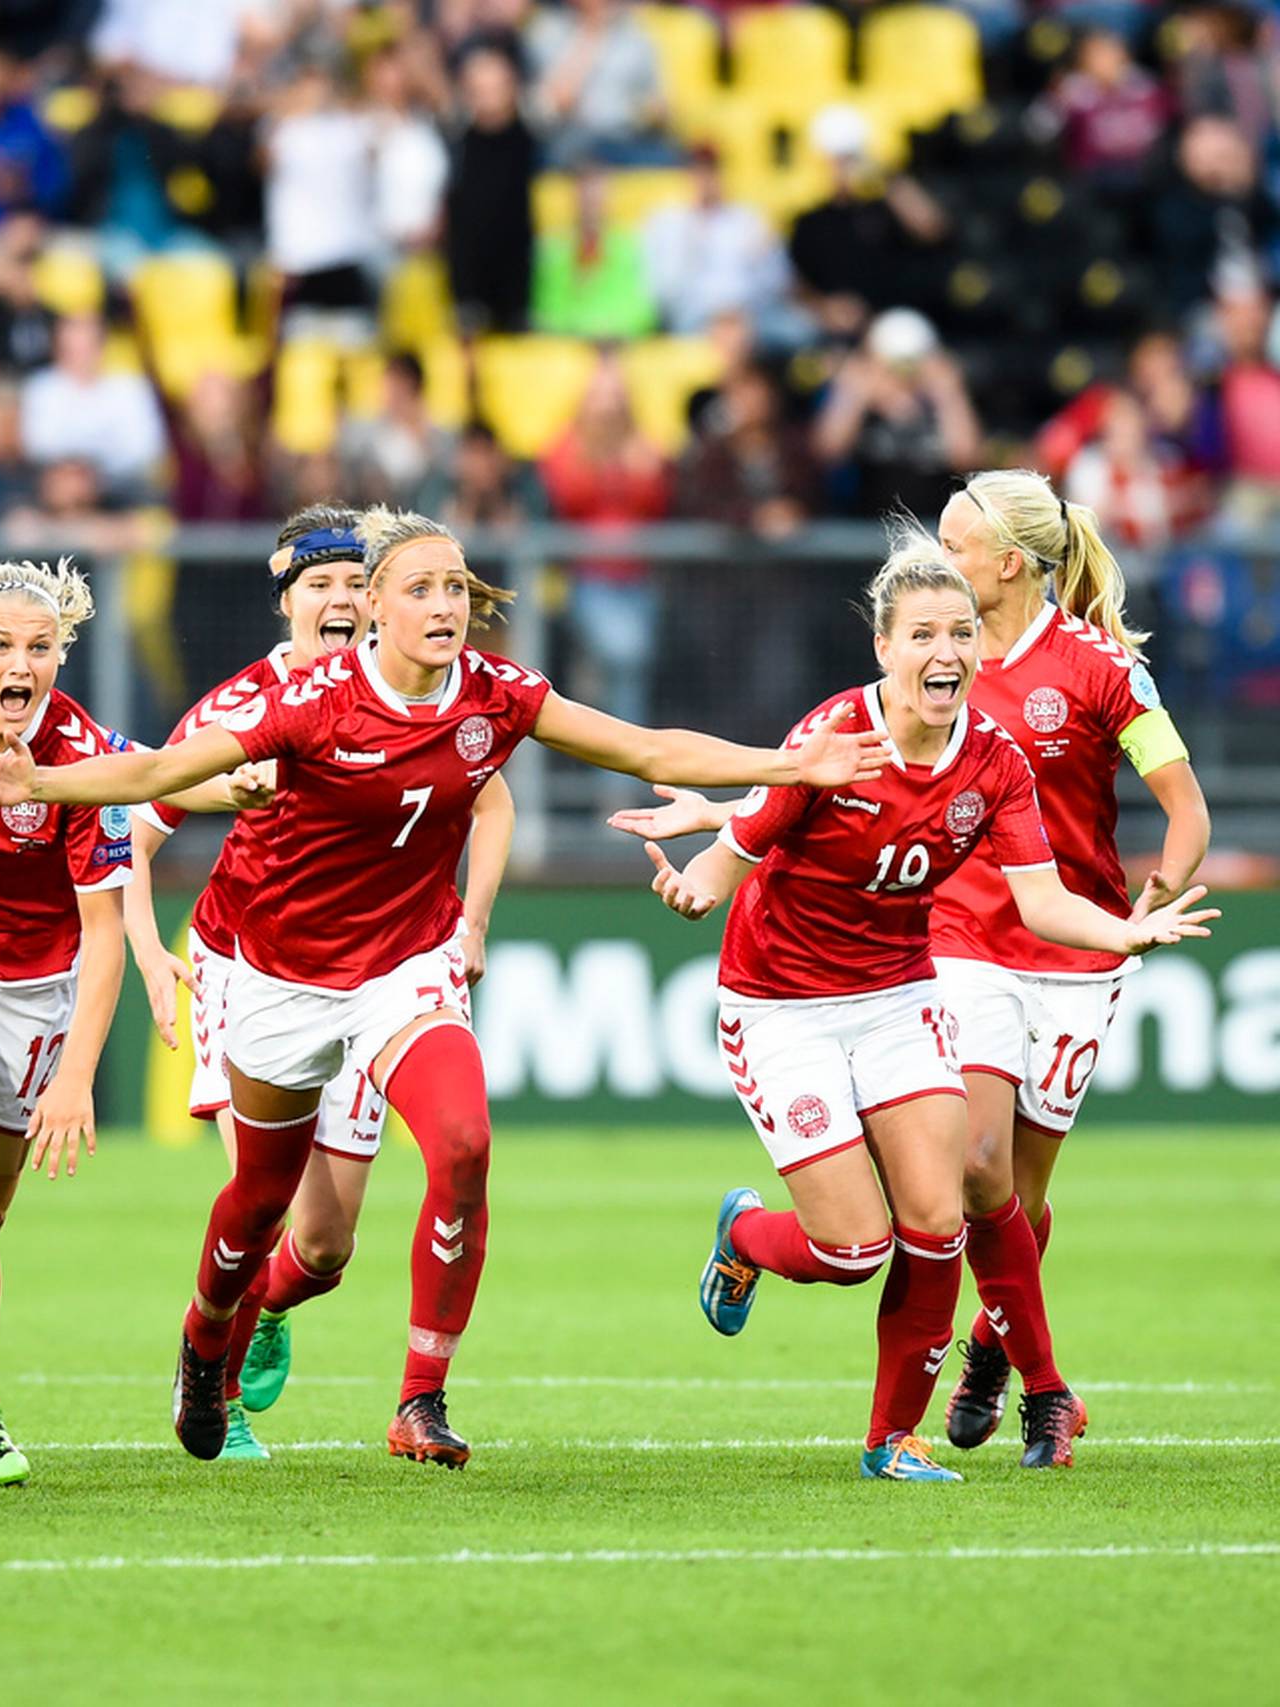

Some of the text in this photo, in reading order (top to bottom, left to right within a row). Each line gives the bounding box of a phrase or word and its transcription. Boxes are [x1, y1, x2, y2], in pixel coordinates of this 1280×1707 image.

[334, 747, 386, 764] hummel
[392, 785, 434, 848] 7
[1039, 1033, 1099, 1100] 10
